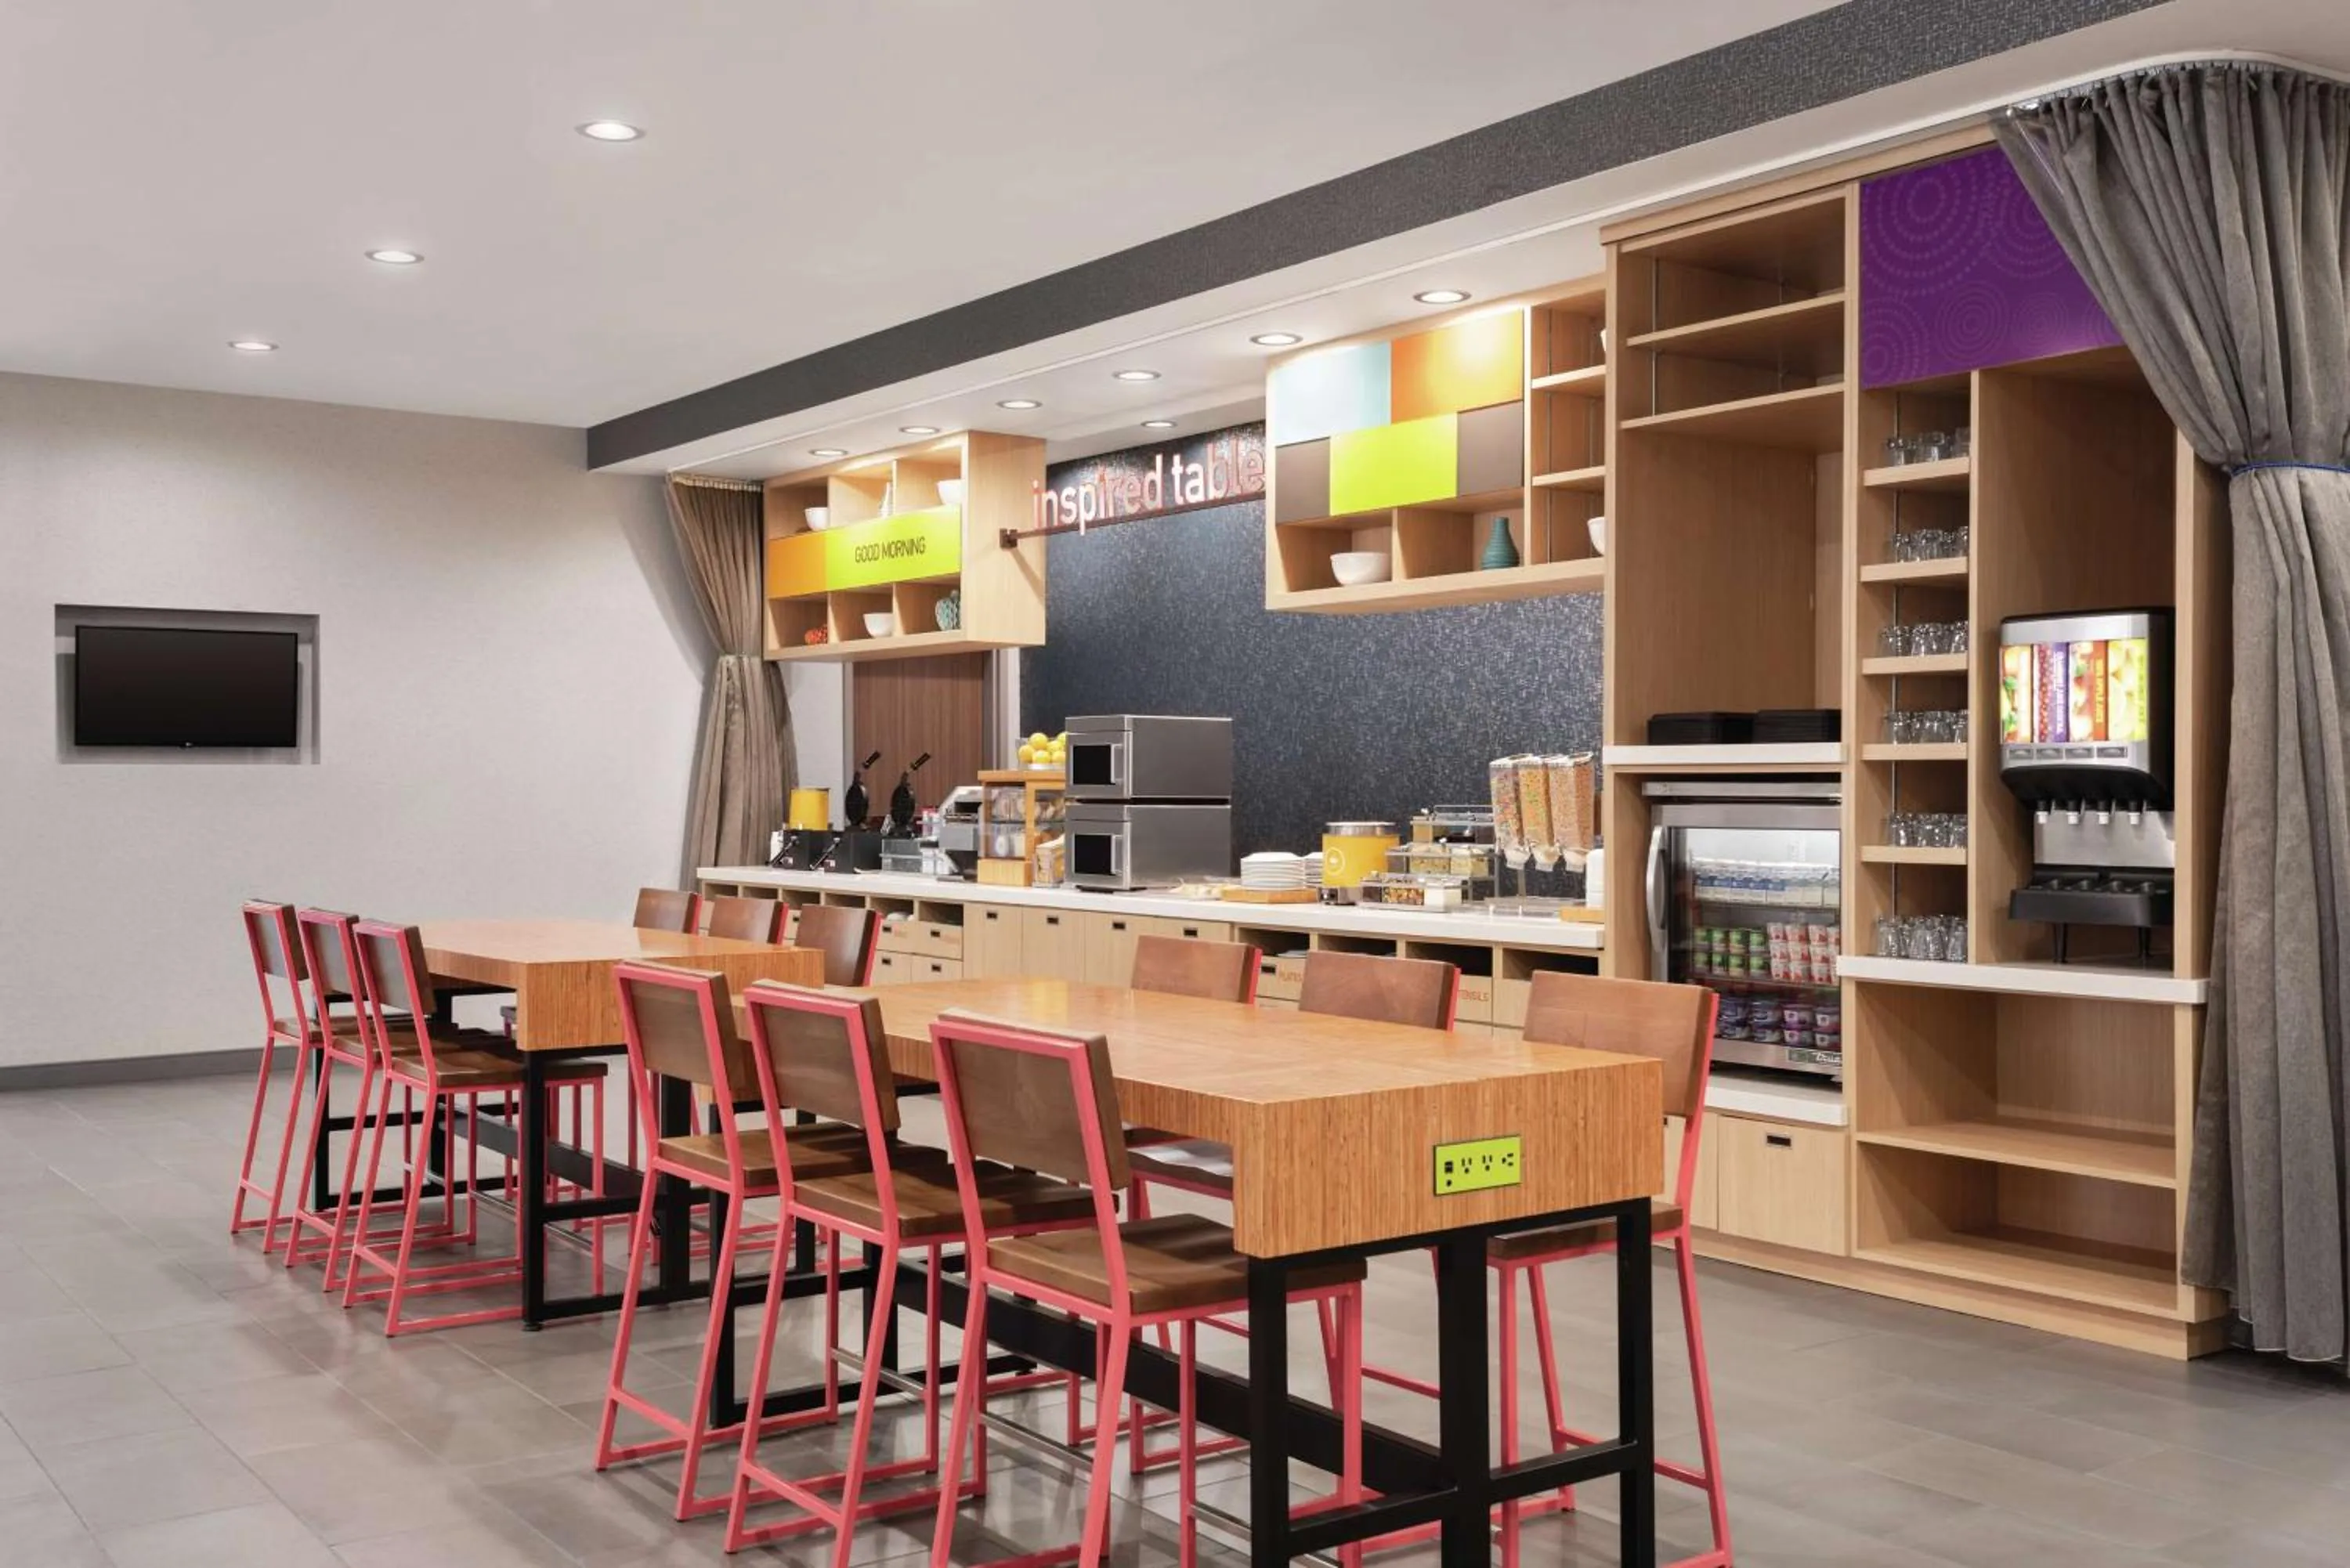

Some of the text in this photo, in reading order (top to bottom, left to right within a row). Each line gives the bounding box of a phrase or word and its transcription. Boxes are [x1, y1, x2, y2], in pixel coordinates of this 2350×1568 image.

[1032, 438, 1266, 537] inspired table
[855, 536, 927, 563] GOOD MORNING
